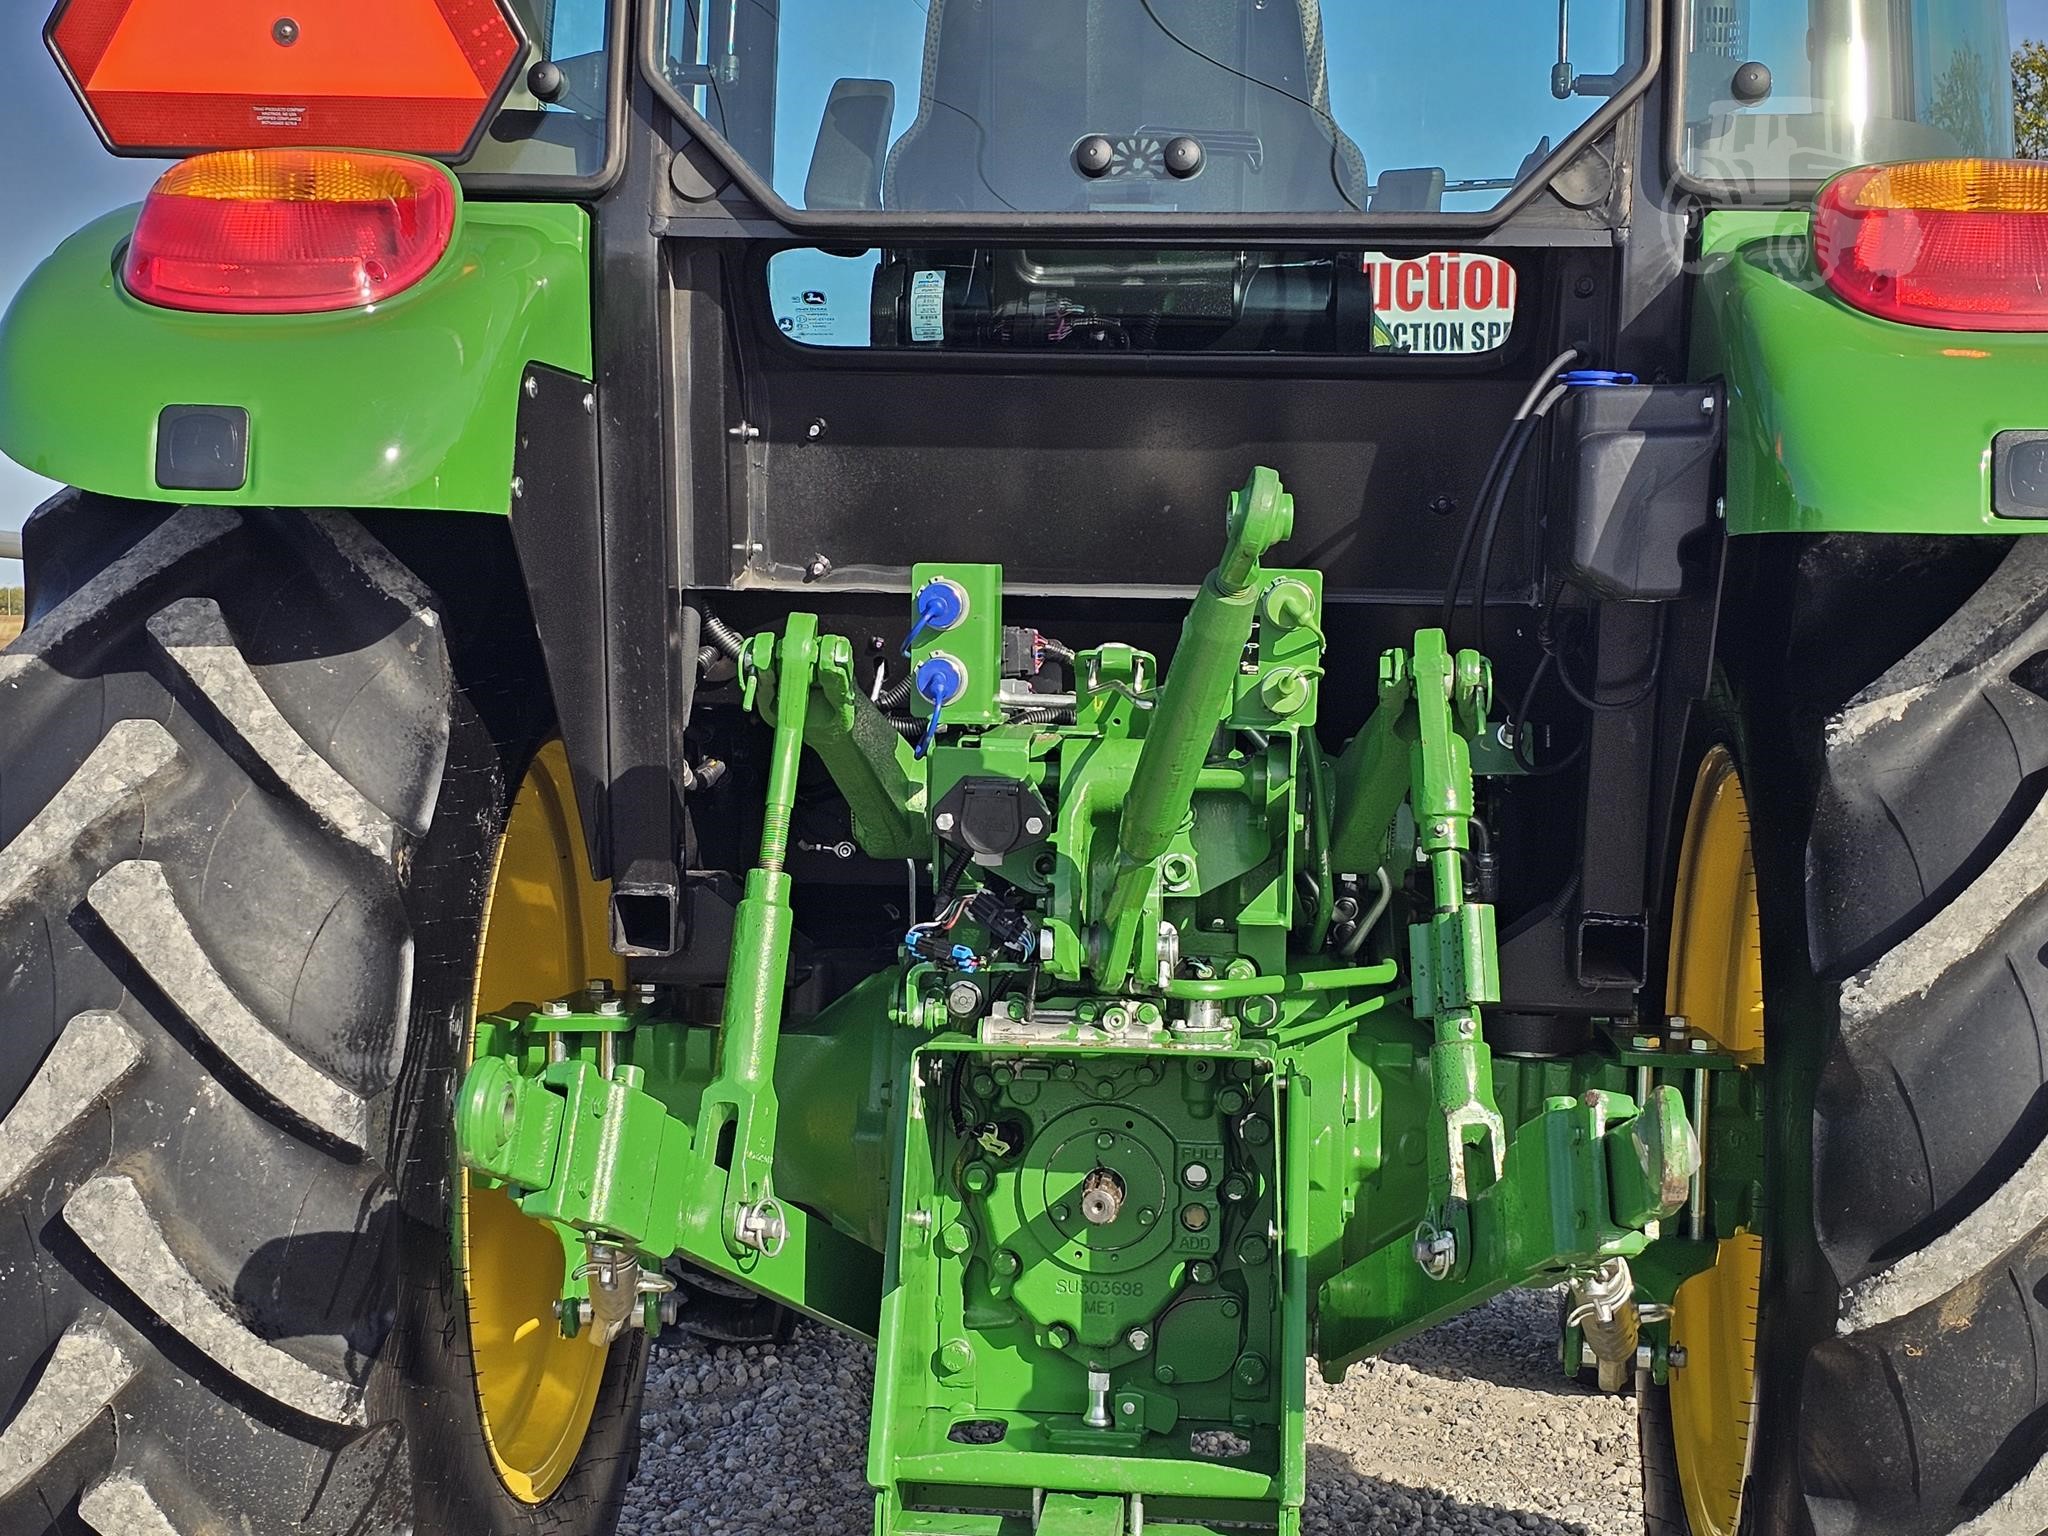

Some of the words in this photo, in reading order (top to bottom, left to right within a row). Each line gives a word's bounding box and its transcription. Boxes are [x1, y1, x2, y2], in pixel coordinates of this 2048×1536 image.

[1387, 321, 1464, 352] CTION
[1182, 1147, 1224, 1160] FULL
[1180, 1236, 1211, 1250] ADD
[1083, 1301, 1116, 1316] ME1
